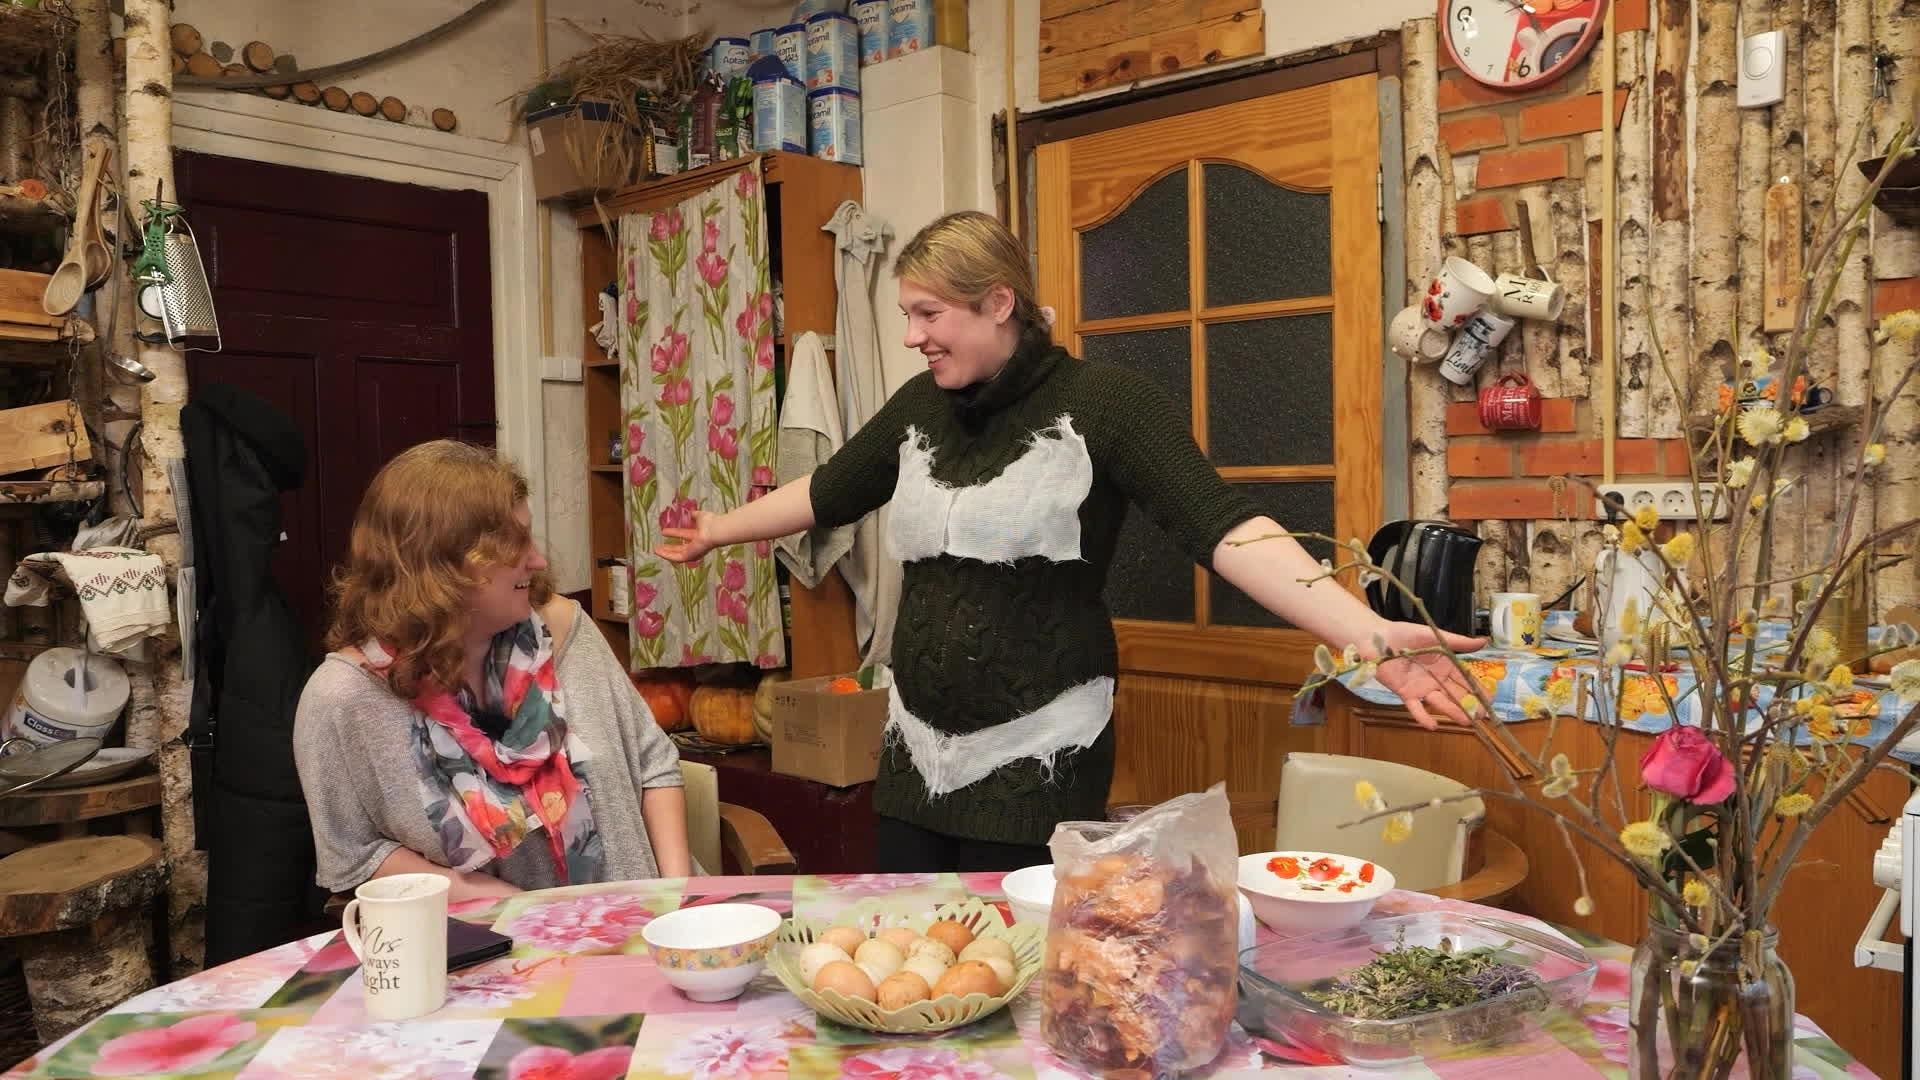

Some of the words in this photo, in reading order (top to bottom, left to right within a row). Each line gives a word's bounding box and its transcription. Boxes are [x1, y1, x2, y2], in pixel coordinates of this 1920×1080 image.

[1463, 47, 1471, 57] 8
[1487, 64, 1494, 75] 7
[1518, 57, 1531, 78] 6
[367, 957, 400, 974] ways
[364, 970, 400, 995] ight
